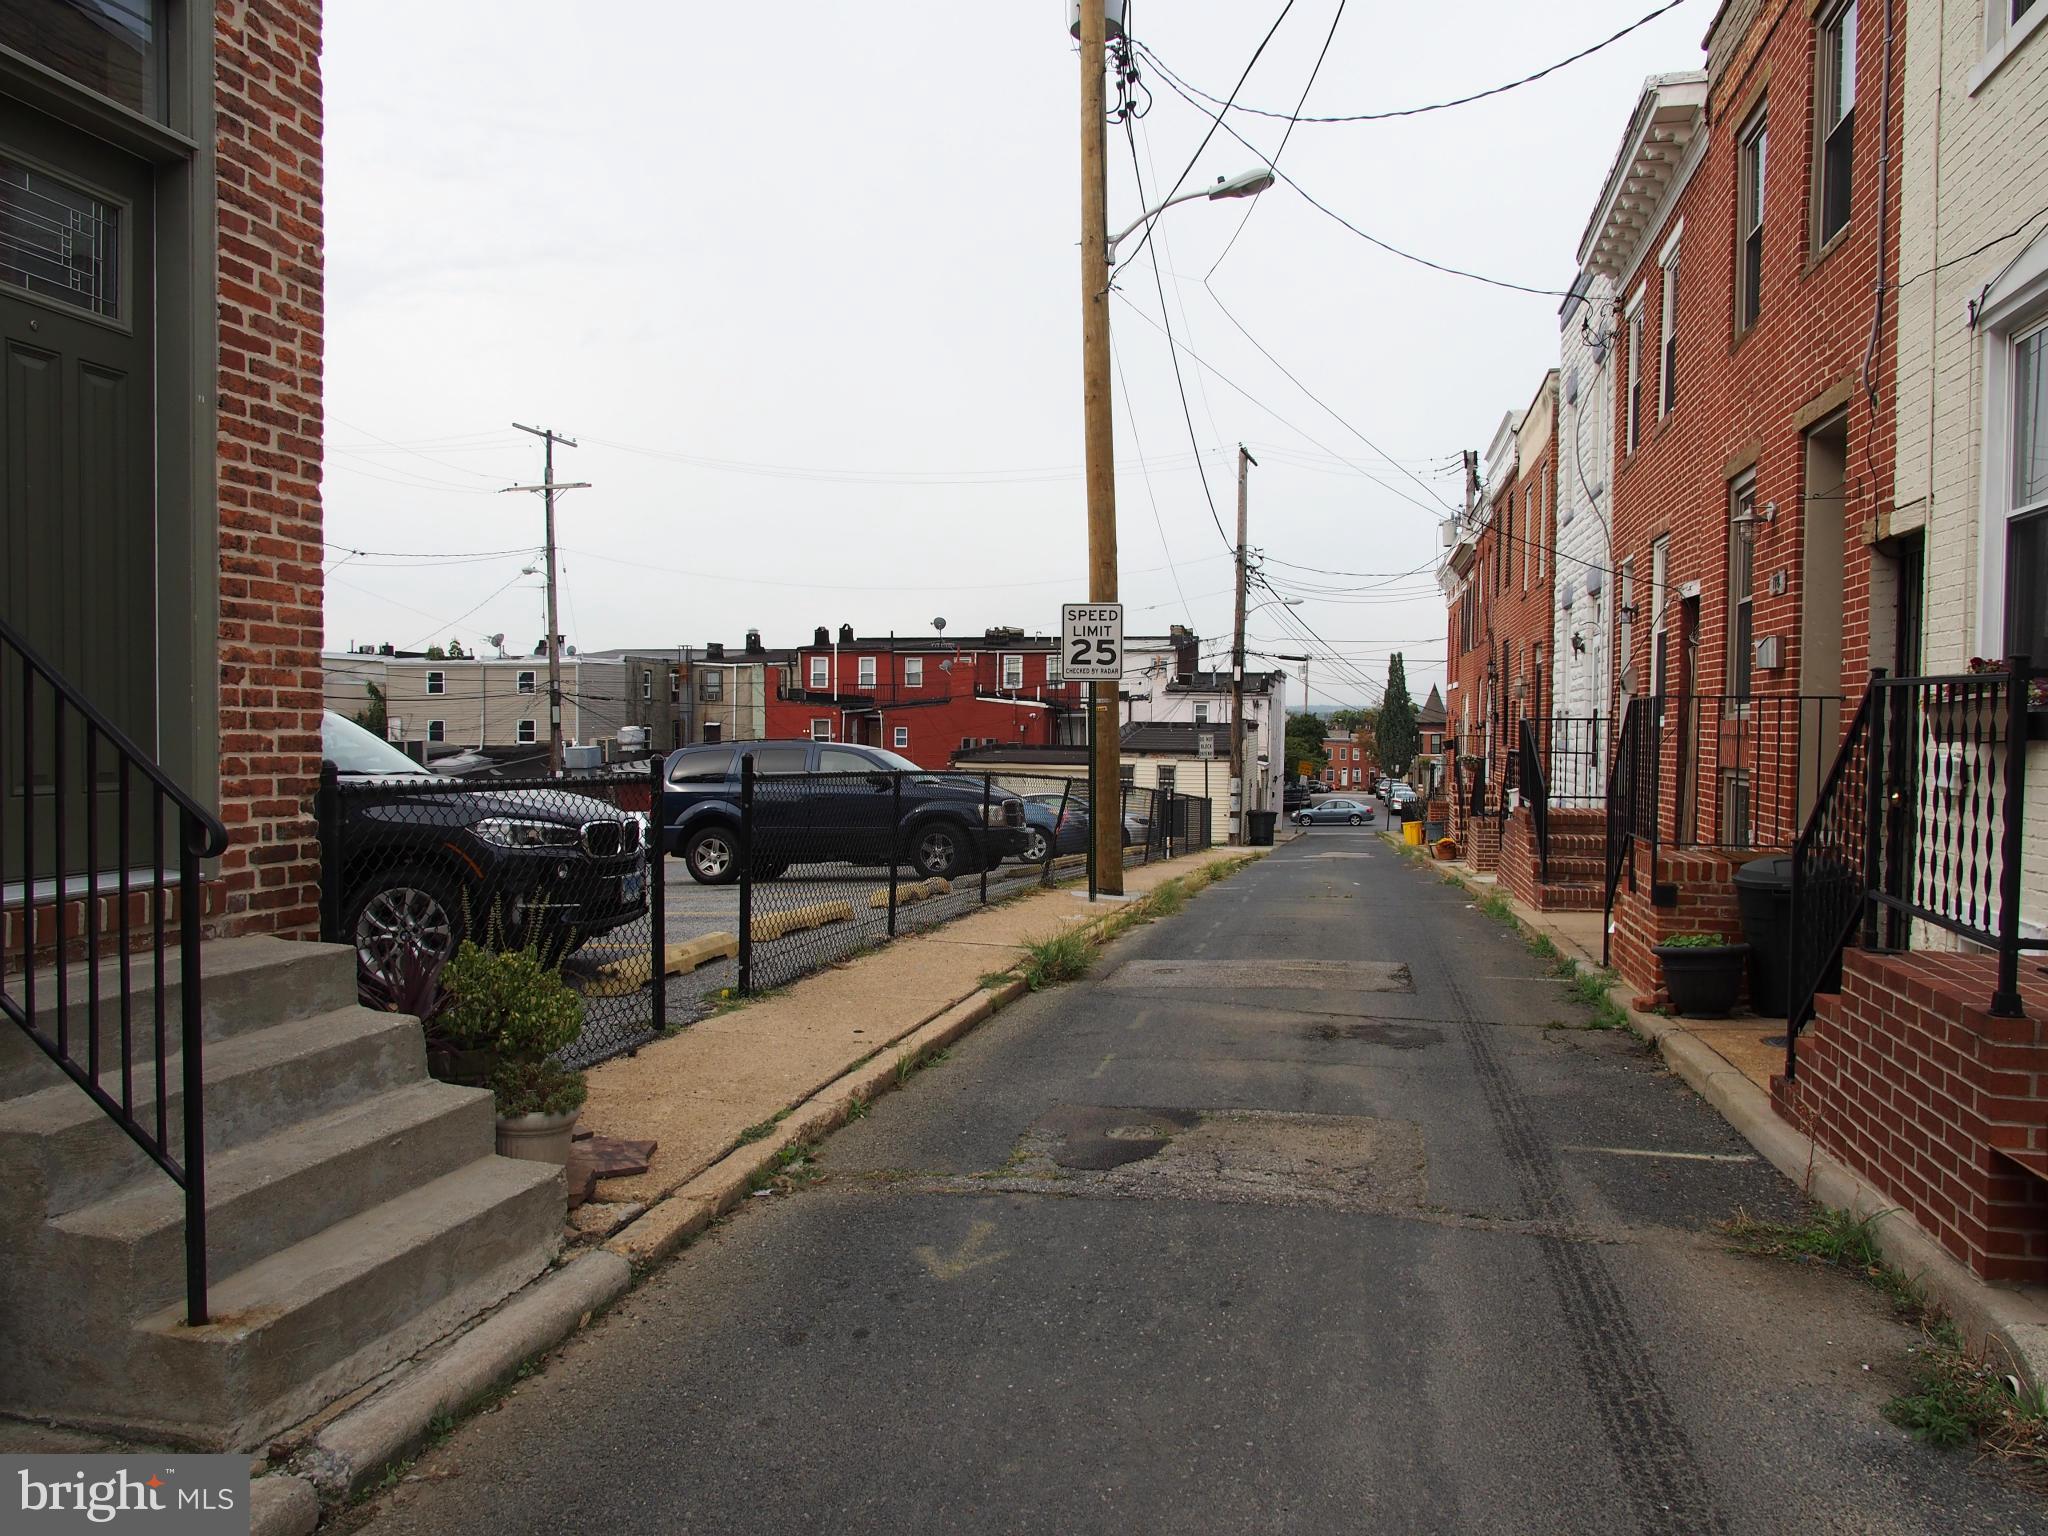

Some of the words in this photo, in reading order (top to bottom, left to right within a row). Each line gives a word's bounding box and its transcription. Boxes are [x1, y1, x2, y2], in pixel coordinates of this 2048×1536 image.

[1068, 610, 1118, 621] SPEED
[1073, 625, 1112, 636] LIMIT
[1071, 639, 1117, 665] 25
